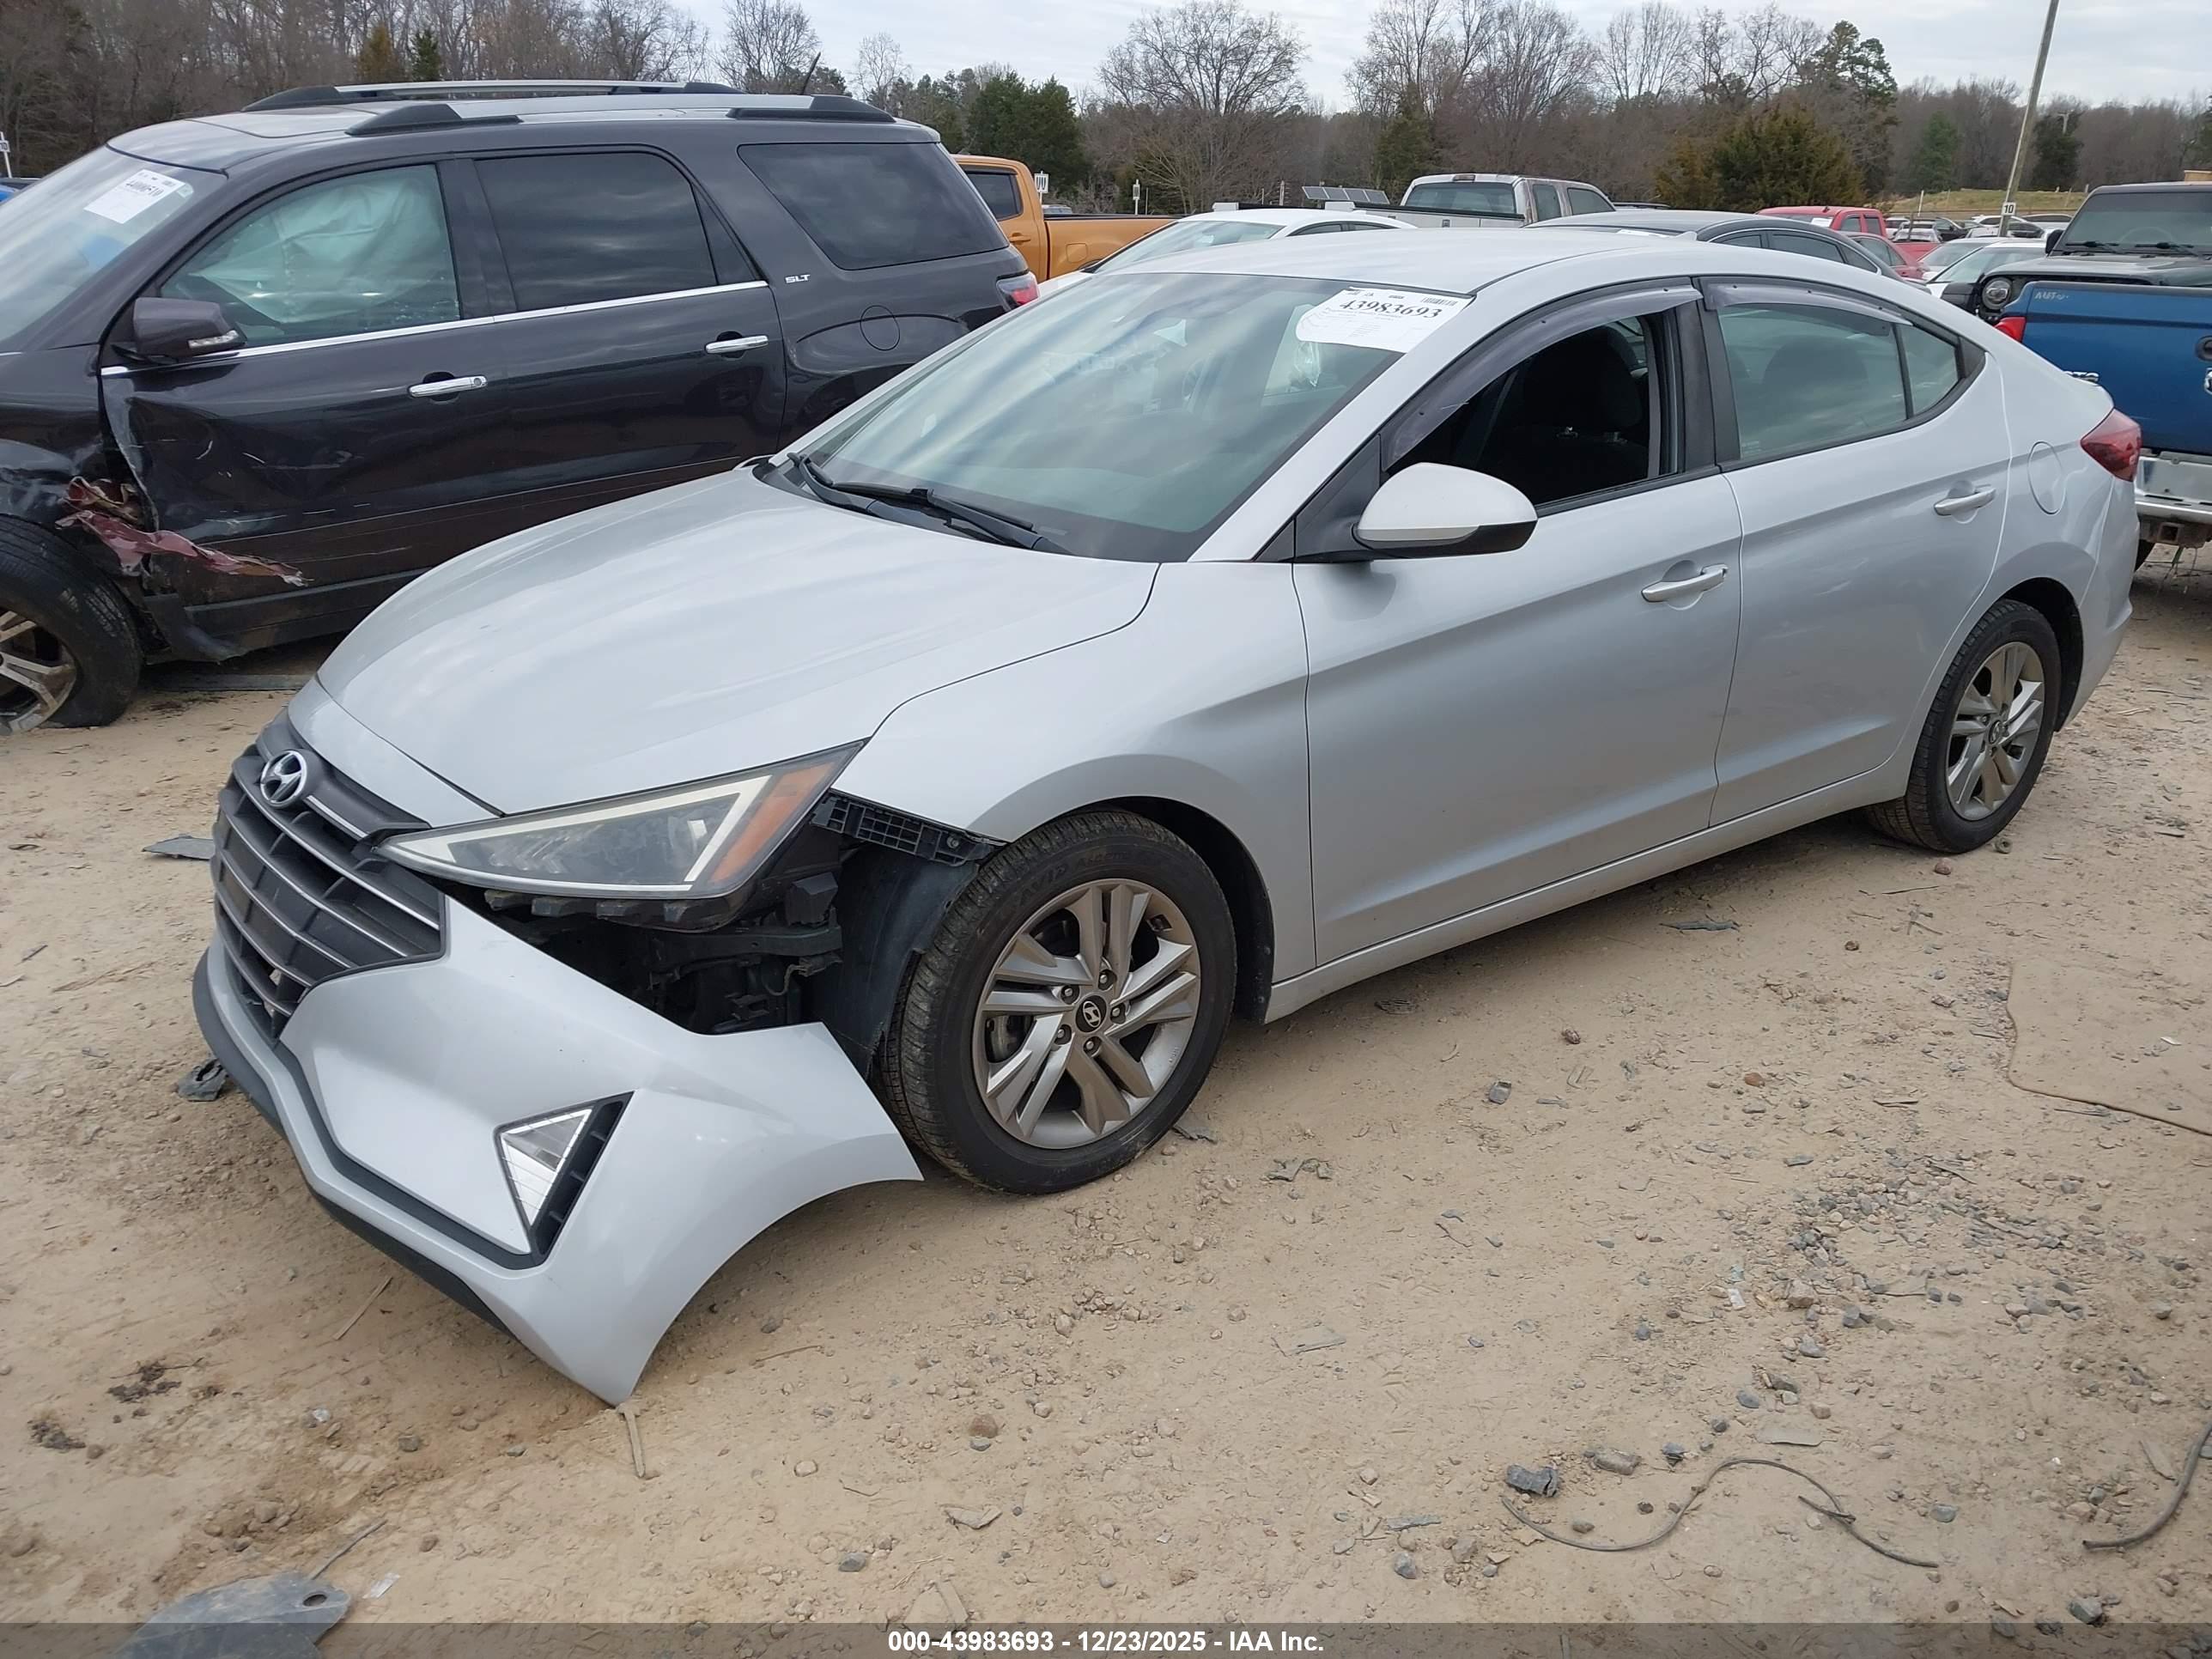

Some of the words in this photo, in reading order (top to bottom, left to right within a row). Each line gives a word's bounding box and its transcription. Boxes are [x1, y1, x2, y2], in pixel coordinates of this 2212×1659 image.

[2004, 204, 2014, 214] 10
[785, 274, 811, 283] SLT
[1340, 300, 1443, 319] 43983693
